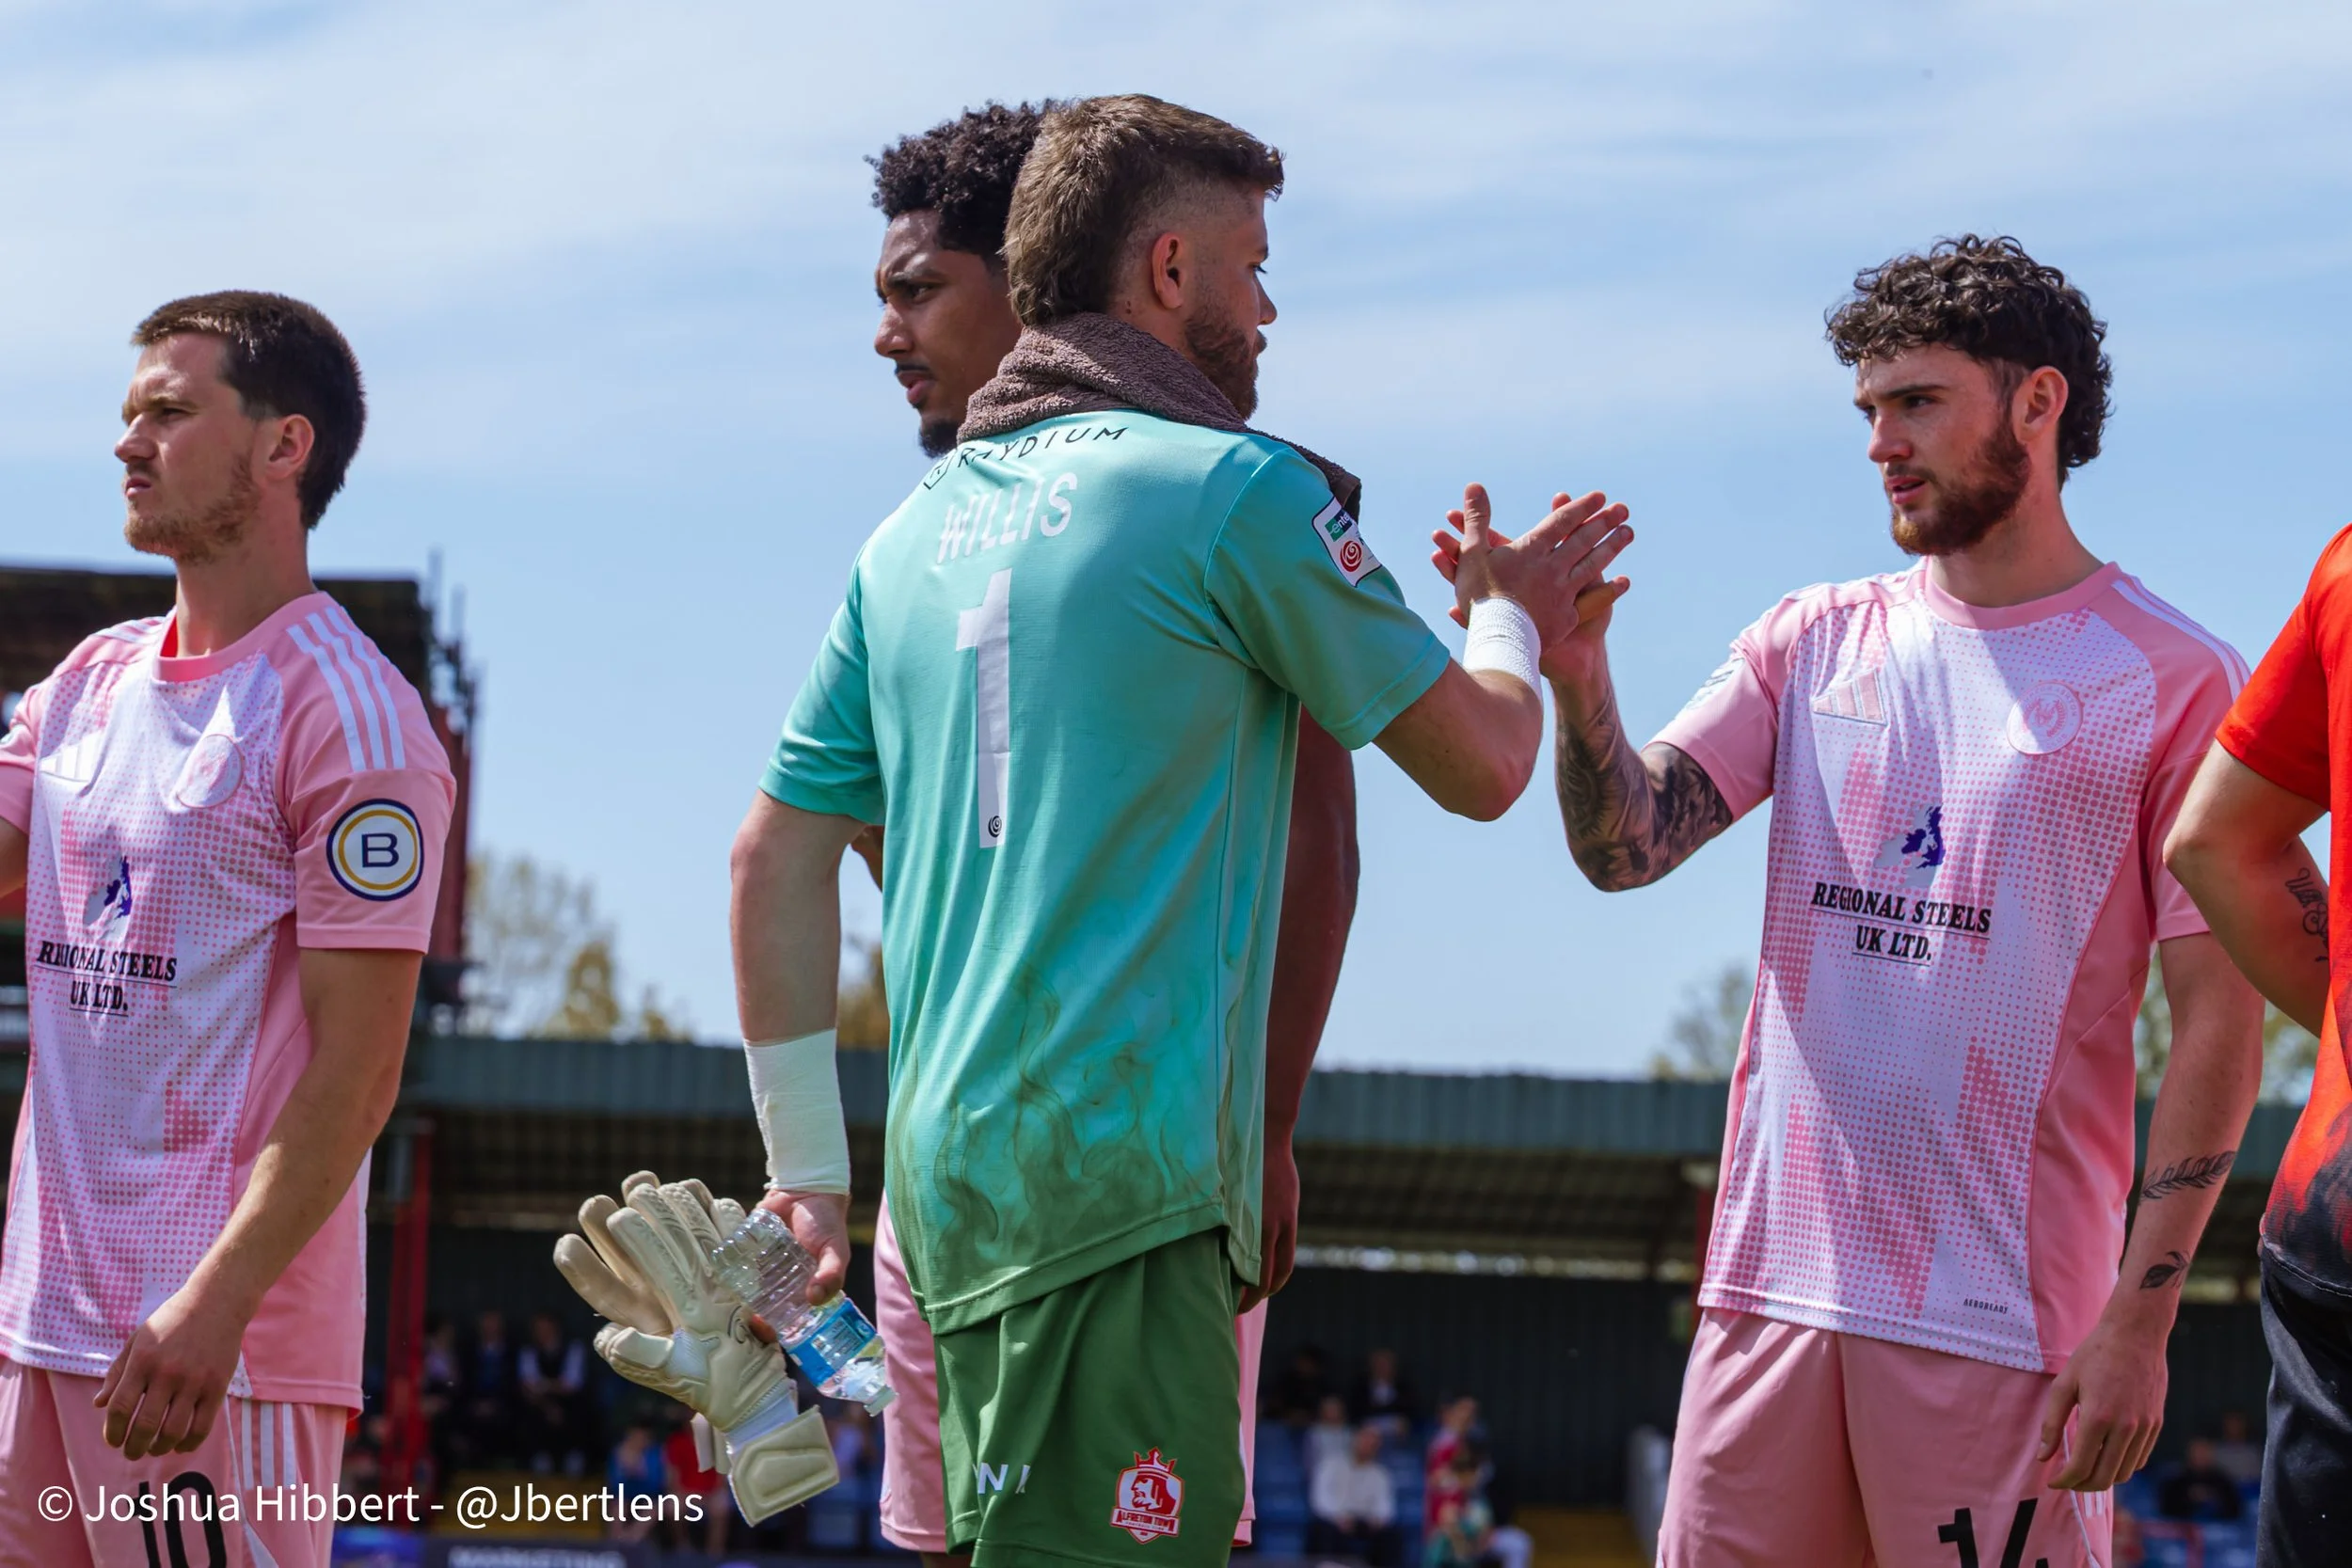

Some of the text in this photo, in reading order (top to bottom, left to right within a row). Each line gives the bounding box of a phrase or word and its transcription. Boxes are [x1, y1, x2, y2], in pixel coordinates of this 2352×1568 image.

[937, 472, 1077, 564] WILLIS
[956, 567, 1012, 848] 1
[361, 832, 400, 868] B
[1811, 881, 1992, 934] REGIONAL STEELS
[1855, 925, 1932, 961] UK LTD.
[109, 950, 178, 982] STEELS
[71, 980, 129, 1012] UK LTD.
